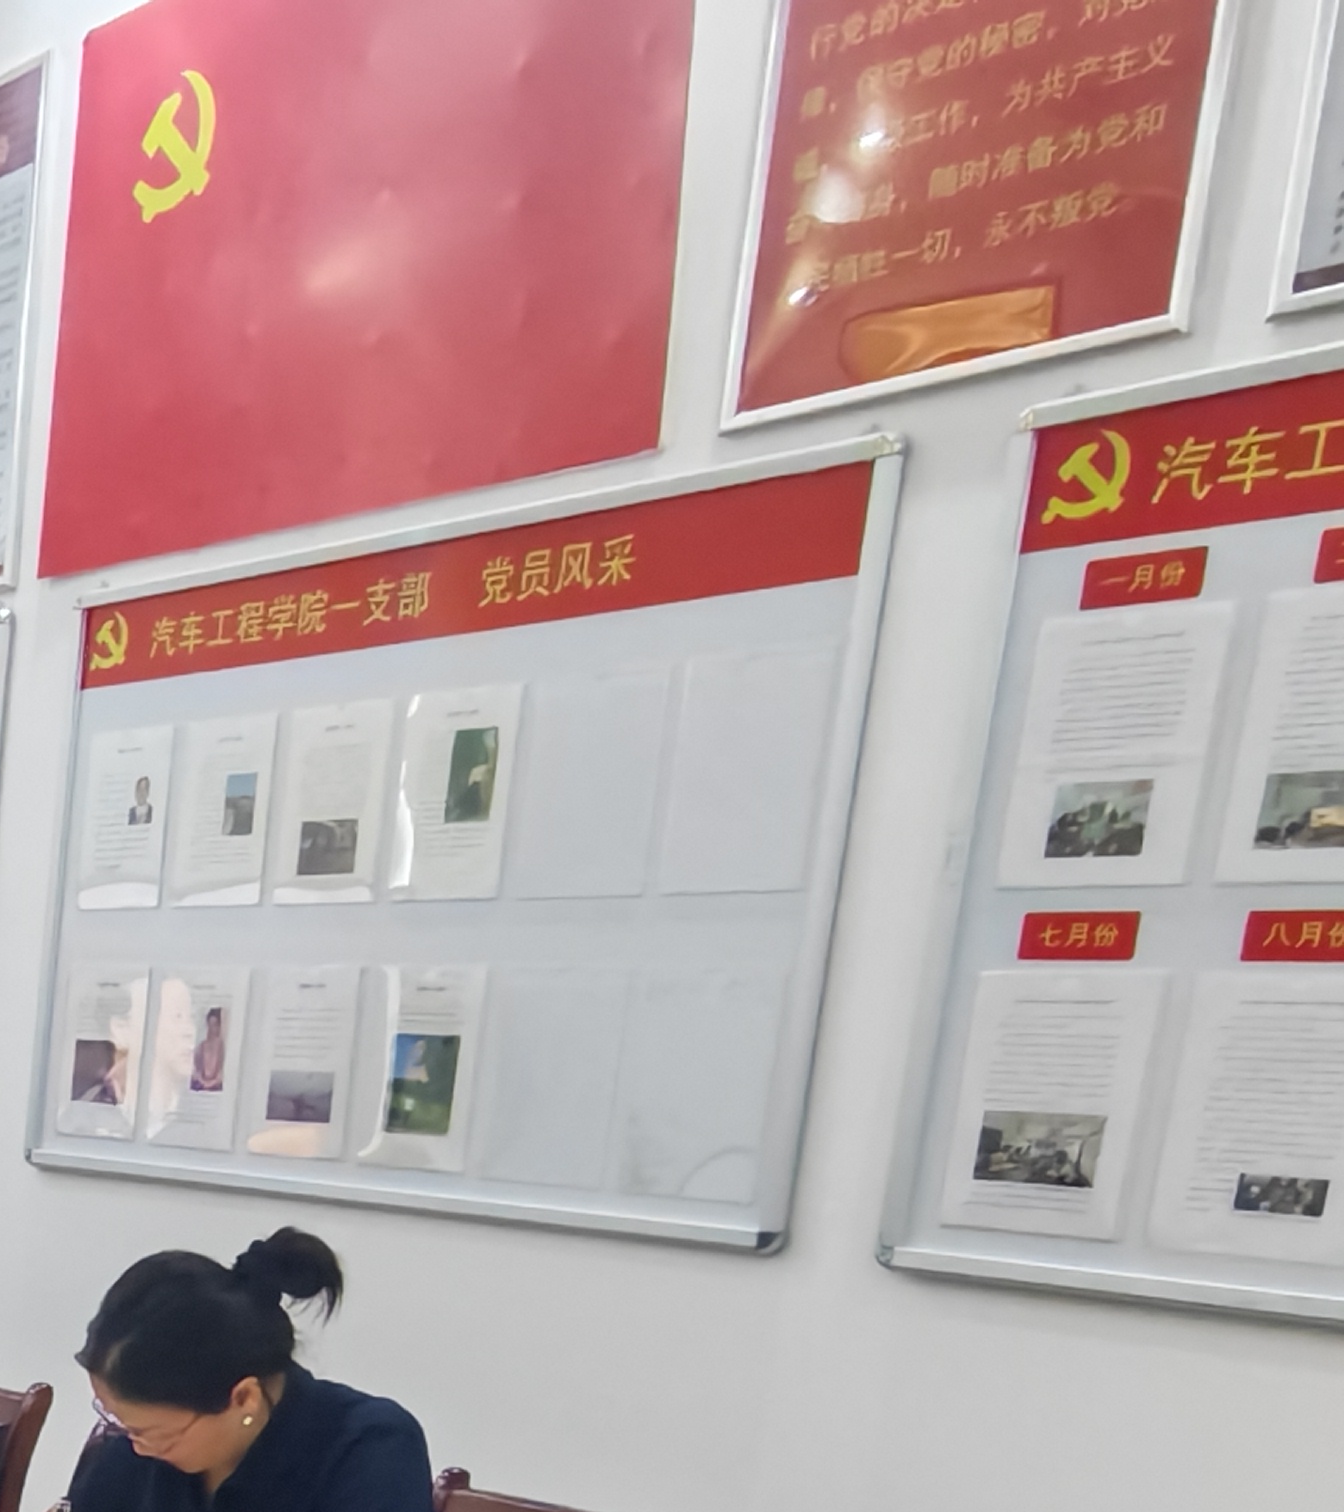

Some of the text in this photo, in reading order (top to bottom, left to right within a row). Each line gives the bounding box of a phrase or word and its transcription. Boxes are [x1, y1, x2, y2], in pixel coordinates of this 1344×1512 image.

[1151, 419, 1344, 504] 汽车工
[149, 533, 637, 659] 汽车工程学院一支部 党员风采
[1099, 560, 1186, 593] 一月份
[1039, 921, 1119, 948] 七月份
